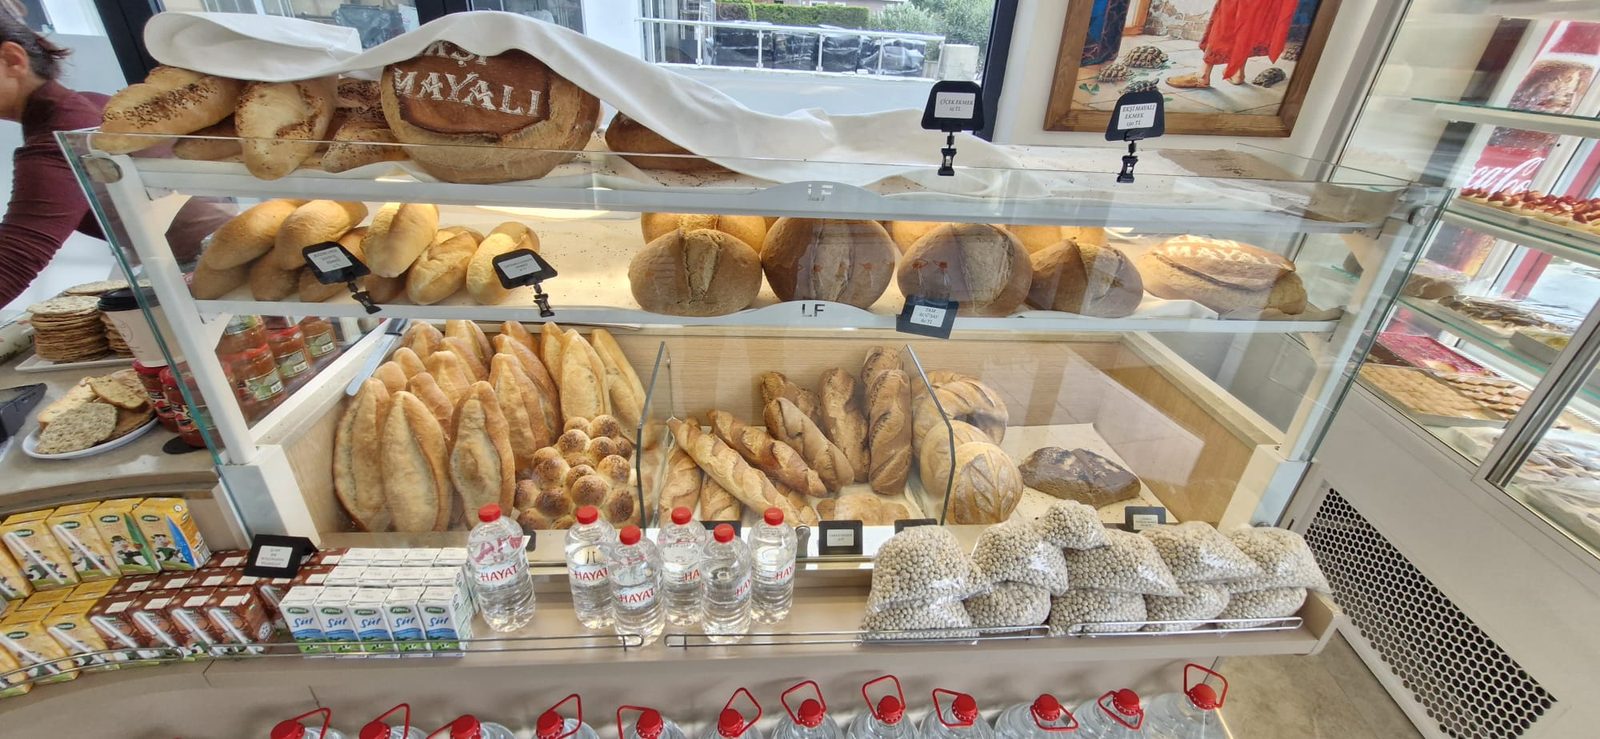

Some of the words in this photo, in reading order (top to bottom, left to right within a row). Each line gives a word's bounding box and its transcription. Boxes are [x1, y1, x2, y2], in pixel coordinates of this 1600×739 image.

[394, 68, 541, 117] MAYALI
[802, 303, 825, 317] LF
[481, 565, 517, 582] HAYAT
[620, 588, 655, 603] HAYAT
[292, 617, 314, 628] Süt
[326, 617, 348, 628] Süt
[360, 617, 381, 628] Süt
[394, 617, 415, 628] Süt
[428, 617, 449, 628] Süt
